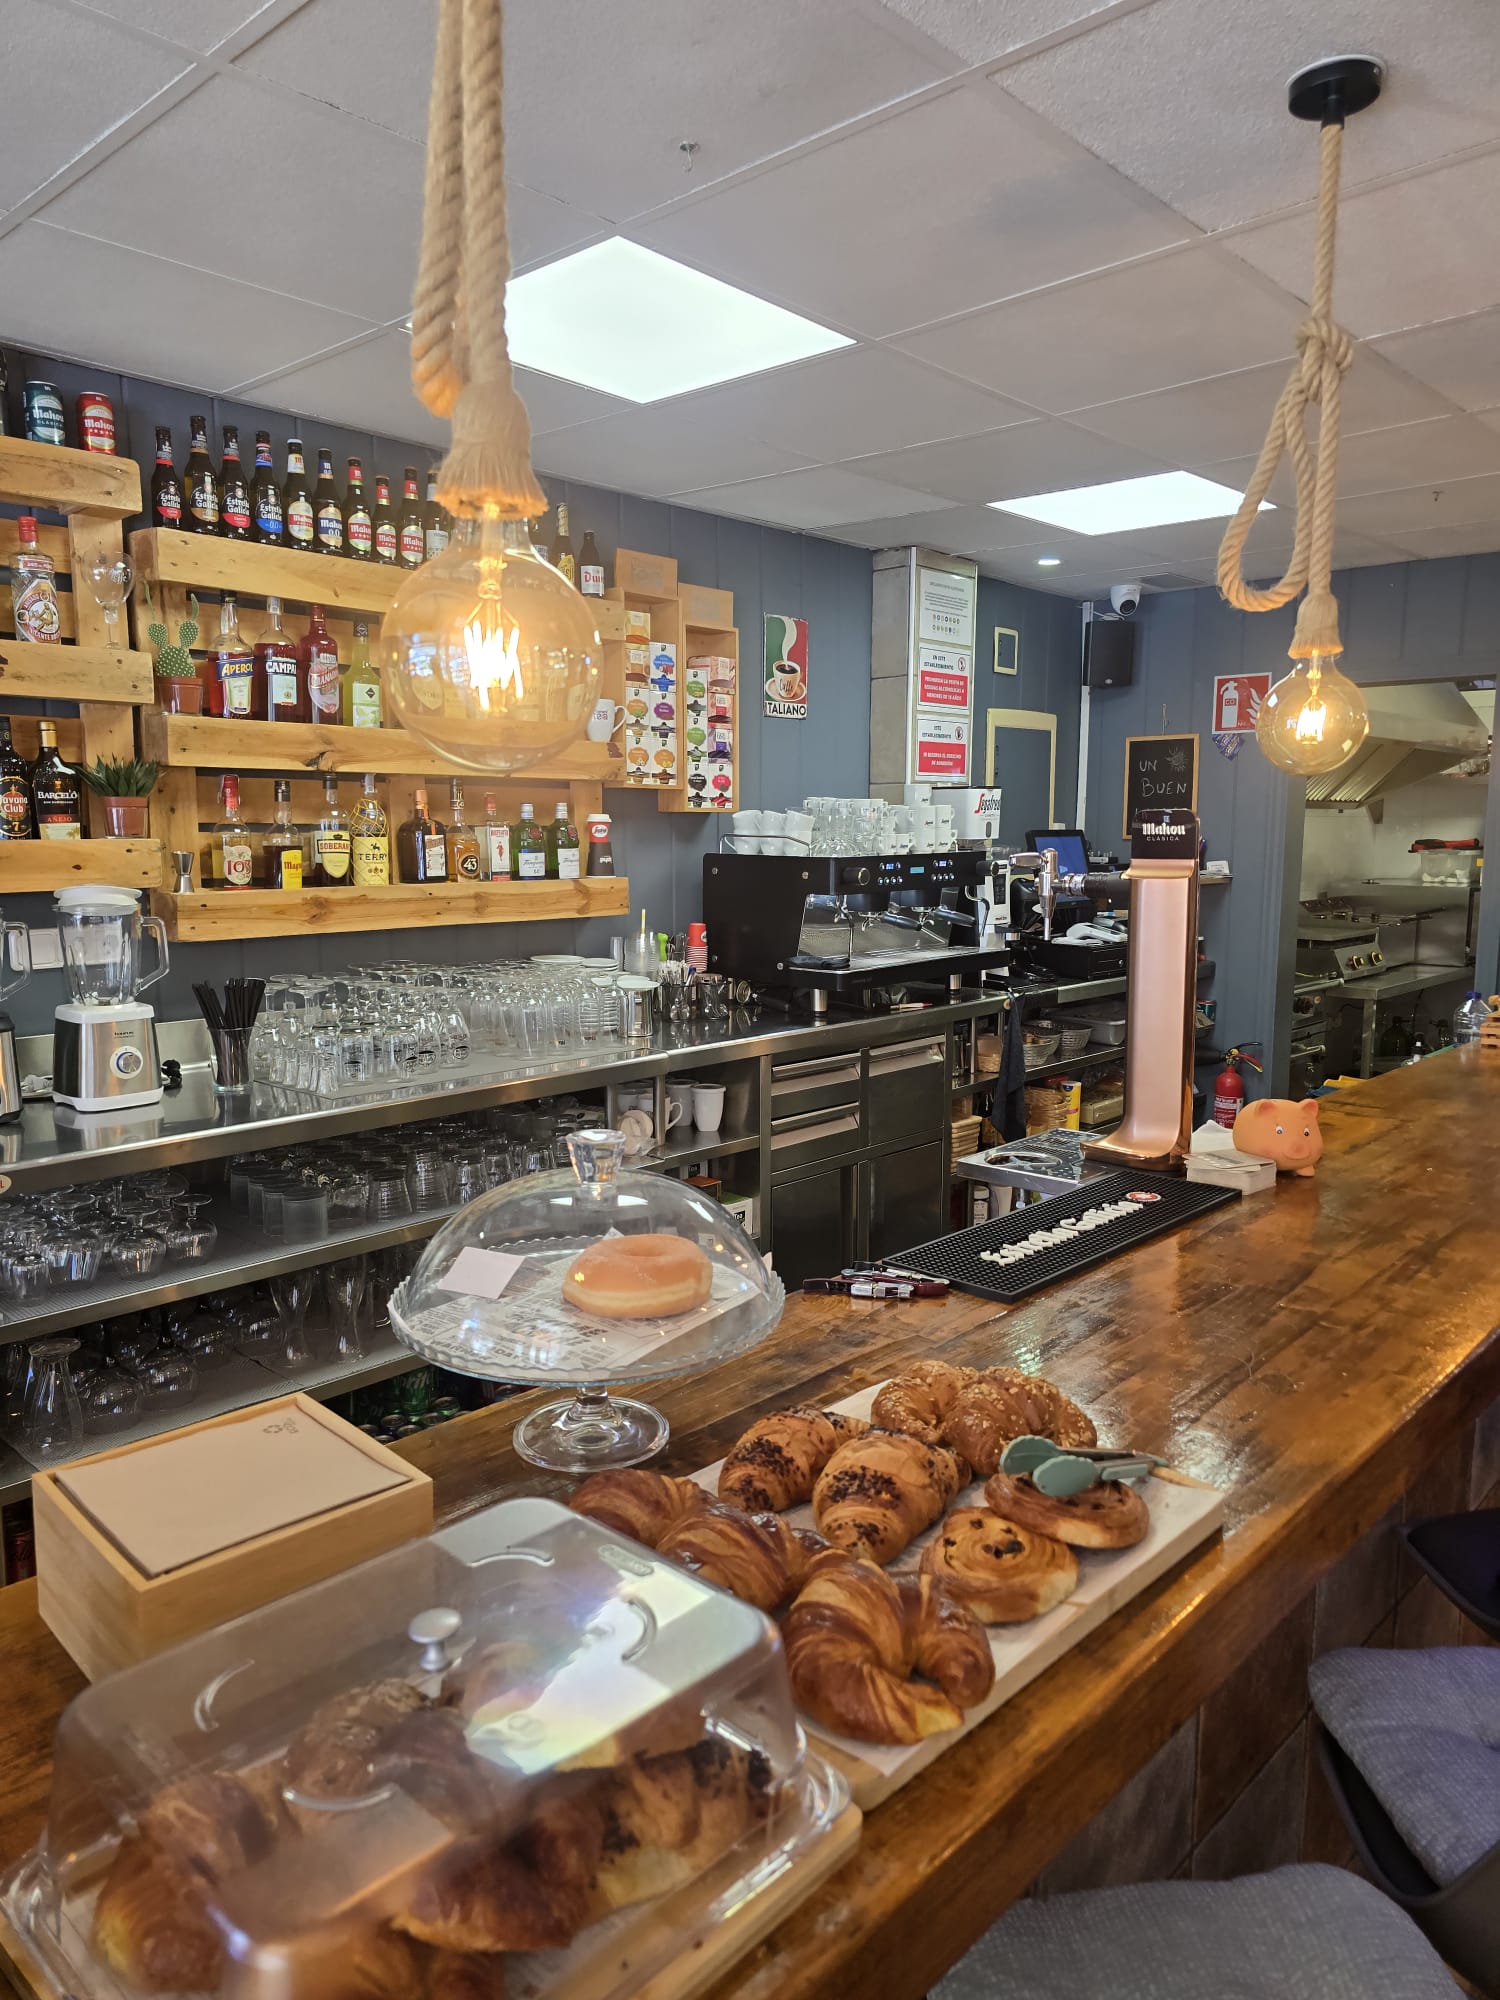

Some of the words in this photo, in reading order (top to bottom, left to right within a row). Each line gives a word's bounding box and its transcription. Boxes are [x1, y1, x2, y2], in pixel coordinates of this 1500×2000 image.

[1141, 778, 1187, 797] BUEN
[3, 803, 24, 813] Club
[12, 822, 19, 831] 7
[1142, 822, 1186, 835] Mahou
[319, 842, 349, 850] SOBERAN
